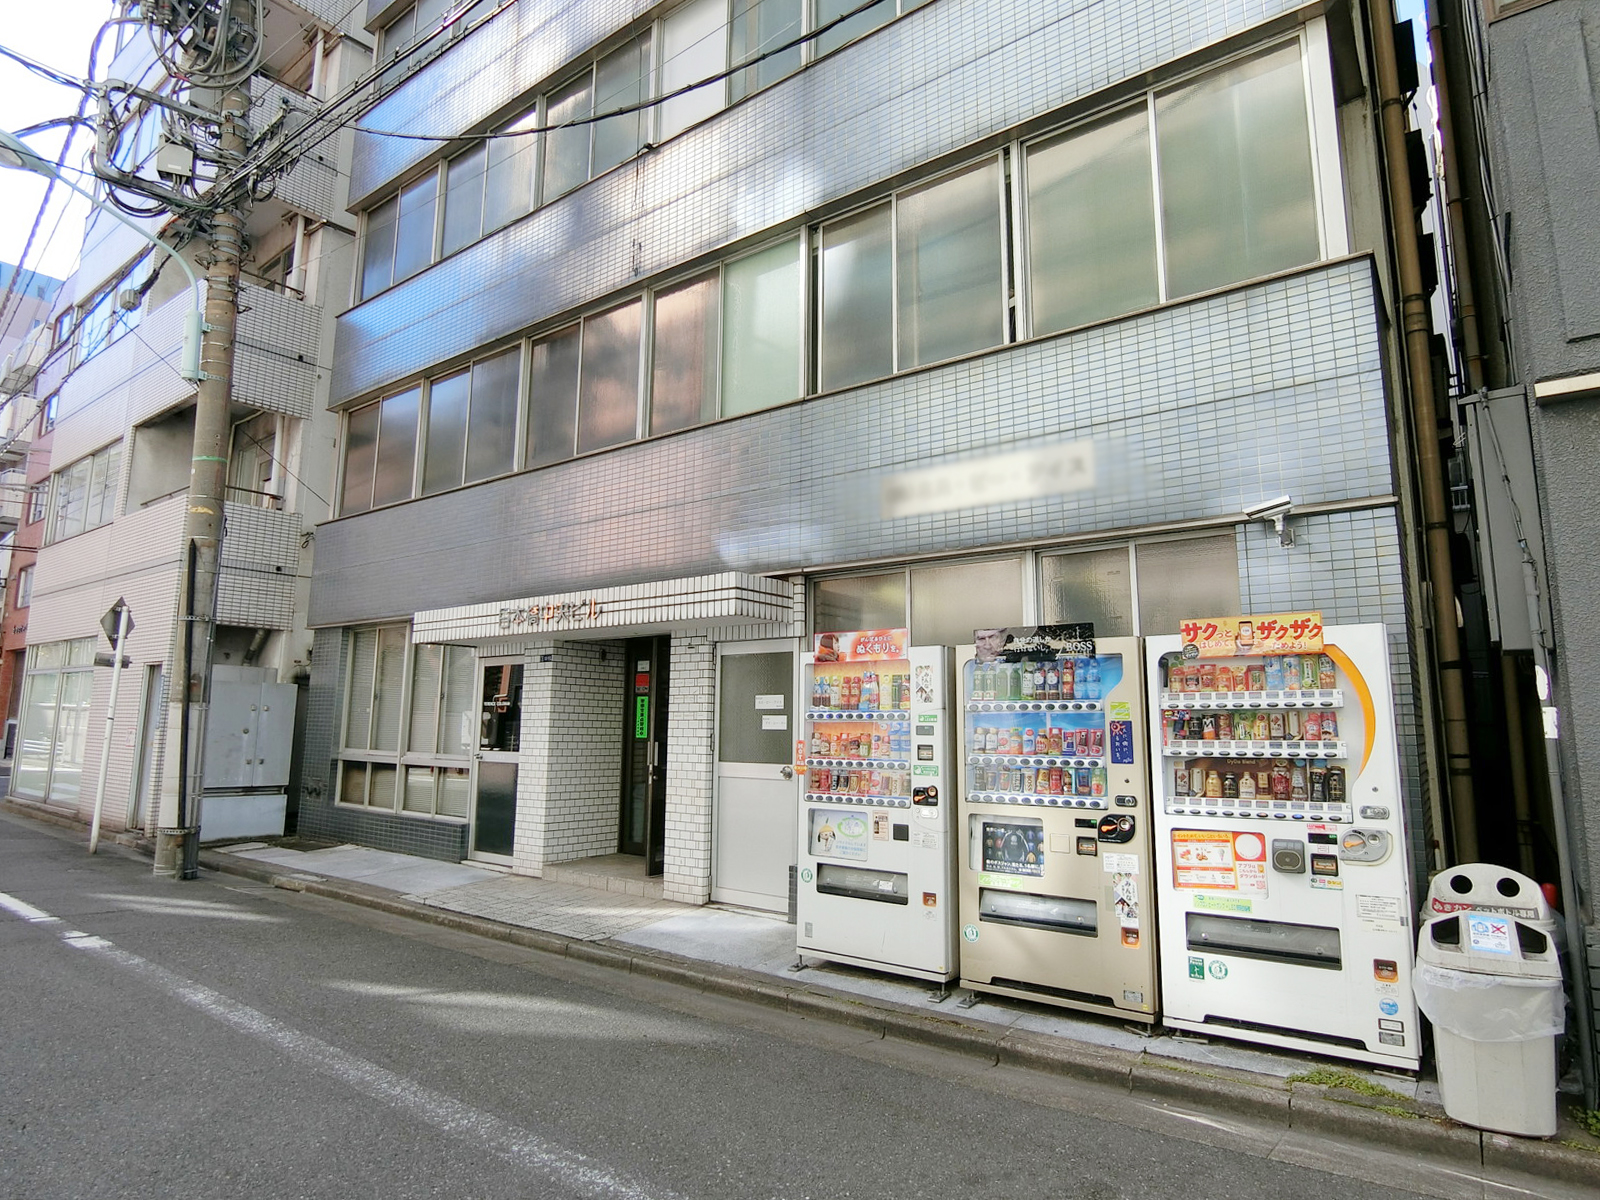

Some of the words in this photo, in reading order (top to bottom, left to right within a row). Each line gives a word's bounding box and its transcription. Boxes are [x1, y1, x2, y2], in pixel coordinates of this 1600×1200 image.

[1181, 622, 1233, 643] サクっと
[1256, 617, 1323, 641] ザクザク
[856, 641, 900, 654] ぬくもりを。
[1066, 640, 1093, 652] BOSS
[1433, 901, 1472, 912] あきカン
